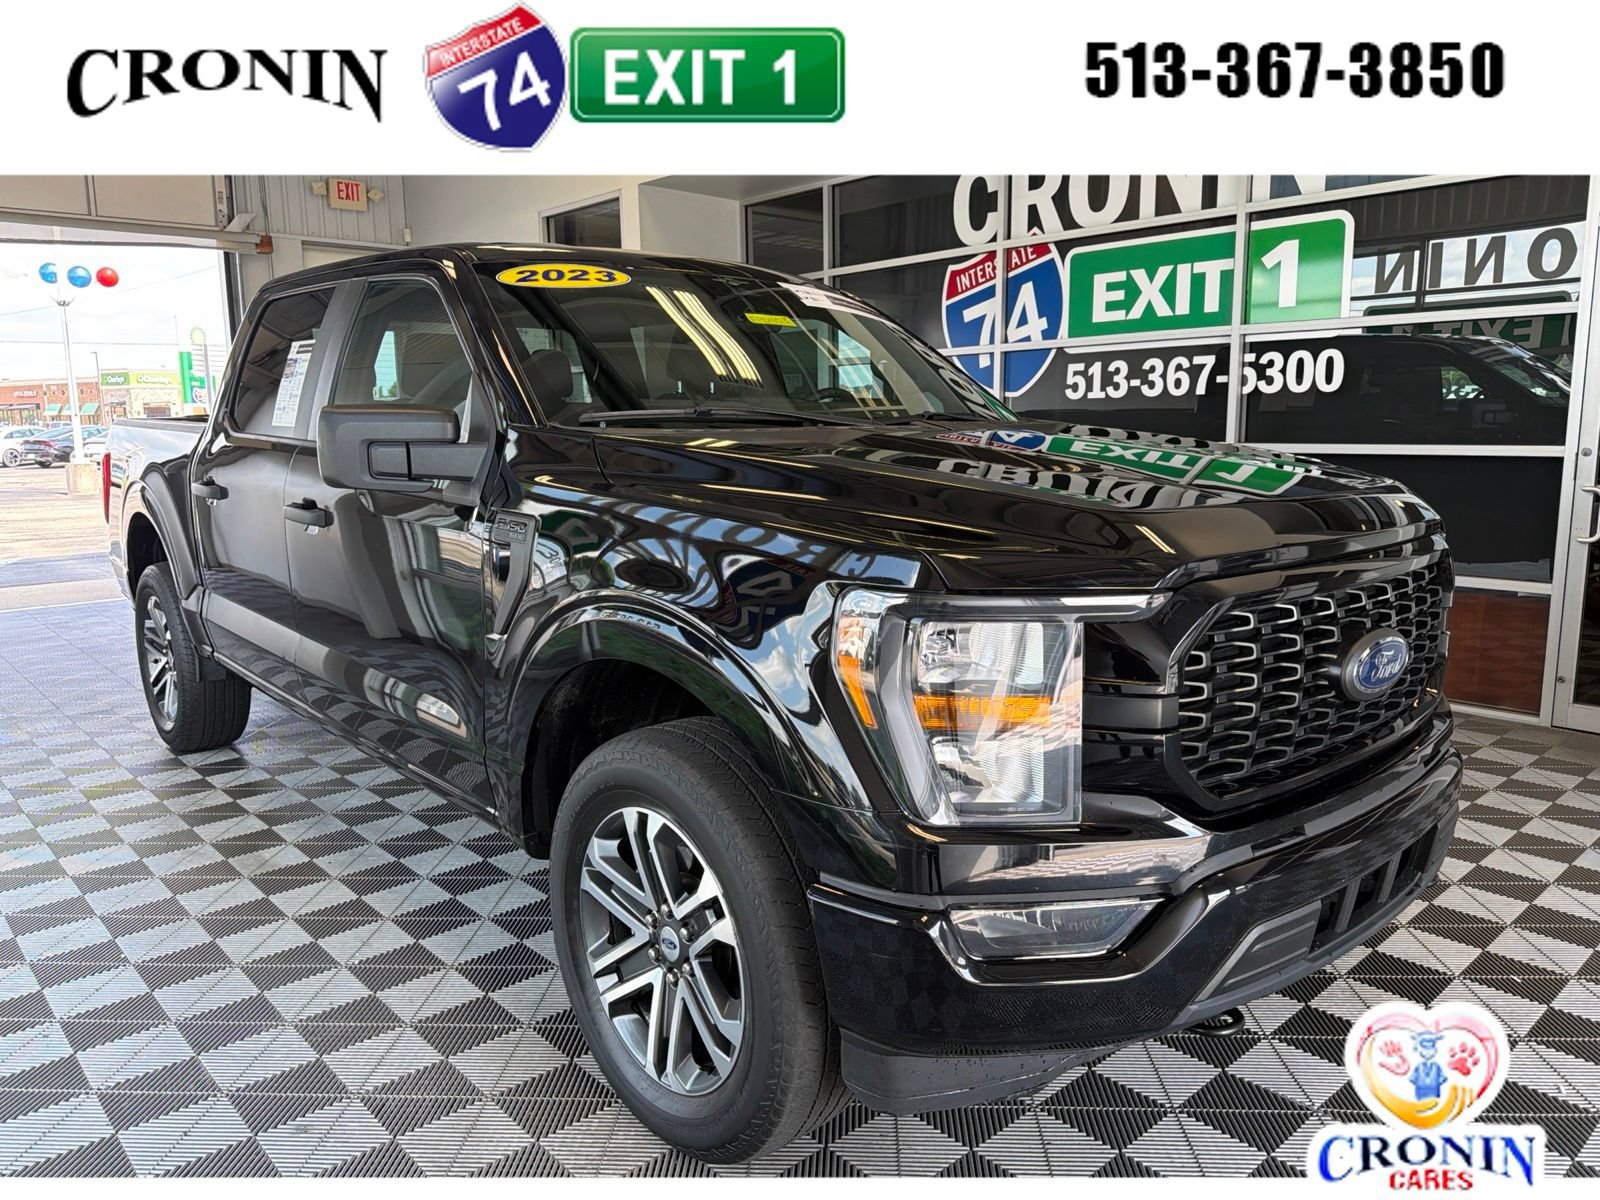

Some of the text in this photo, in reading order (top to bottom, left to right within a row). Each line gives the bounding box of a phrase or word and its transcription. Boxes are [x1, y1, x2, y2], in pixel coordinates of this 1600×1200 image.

[337, 181, 361, 202] EXIT
[953, 175, 1326, 248] CRON
[515, 268, 617, 283] 2023
[956, 245, 1037, 293] INTERATE
[1092, 239, 1300, 323] EXIT 1
[962, 281, 1048, 369] 74
[1065, 348, 1345, 400] 513-367-5300
[1371, 650, 1402, 682] Ford
